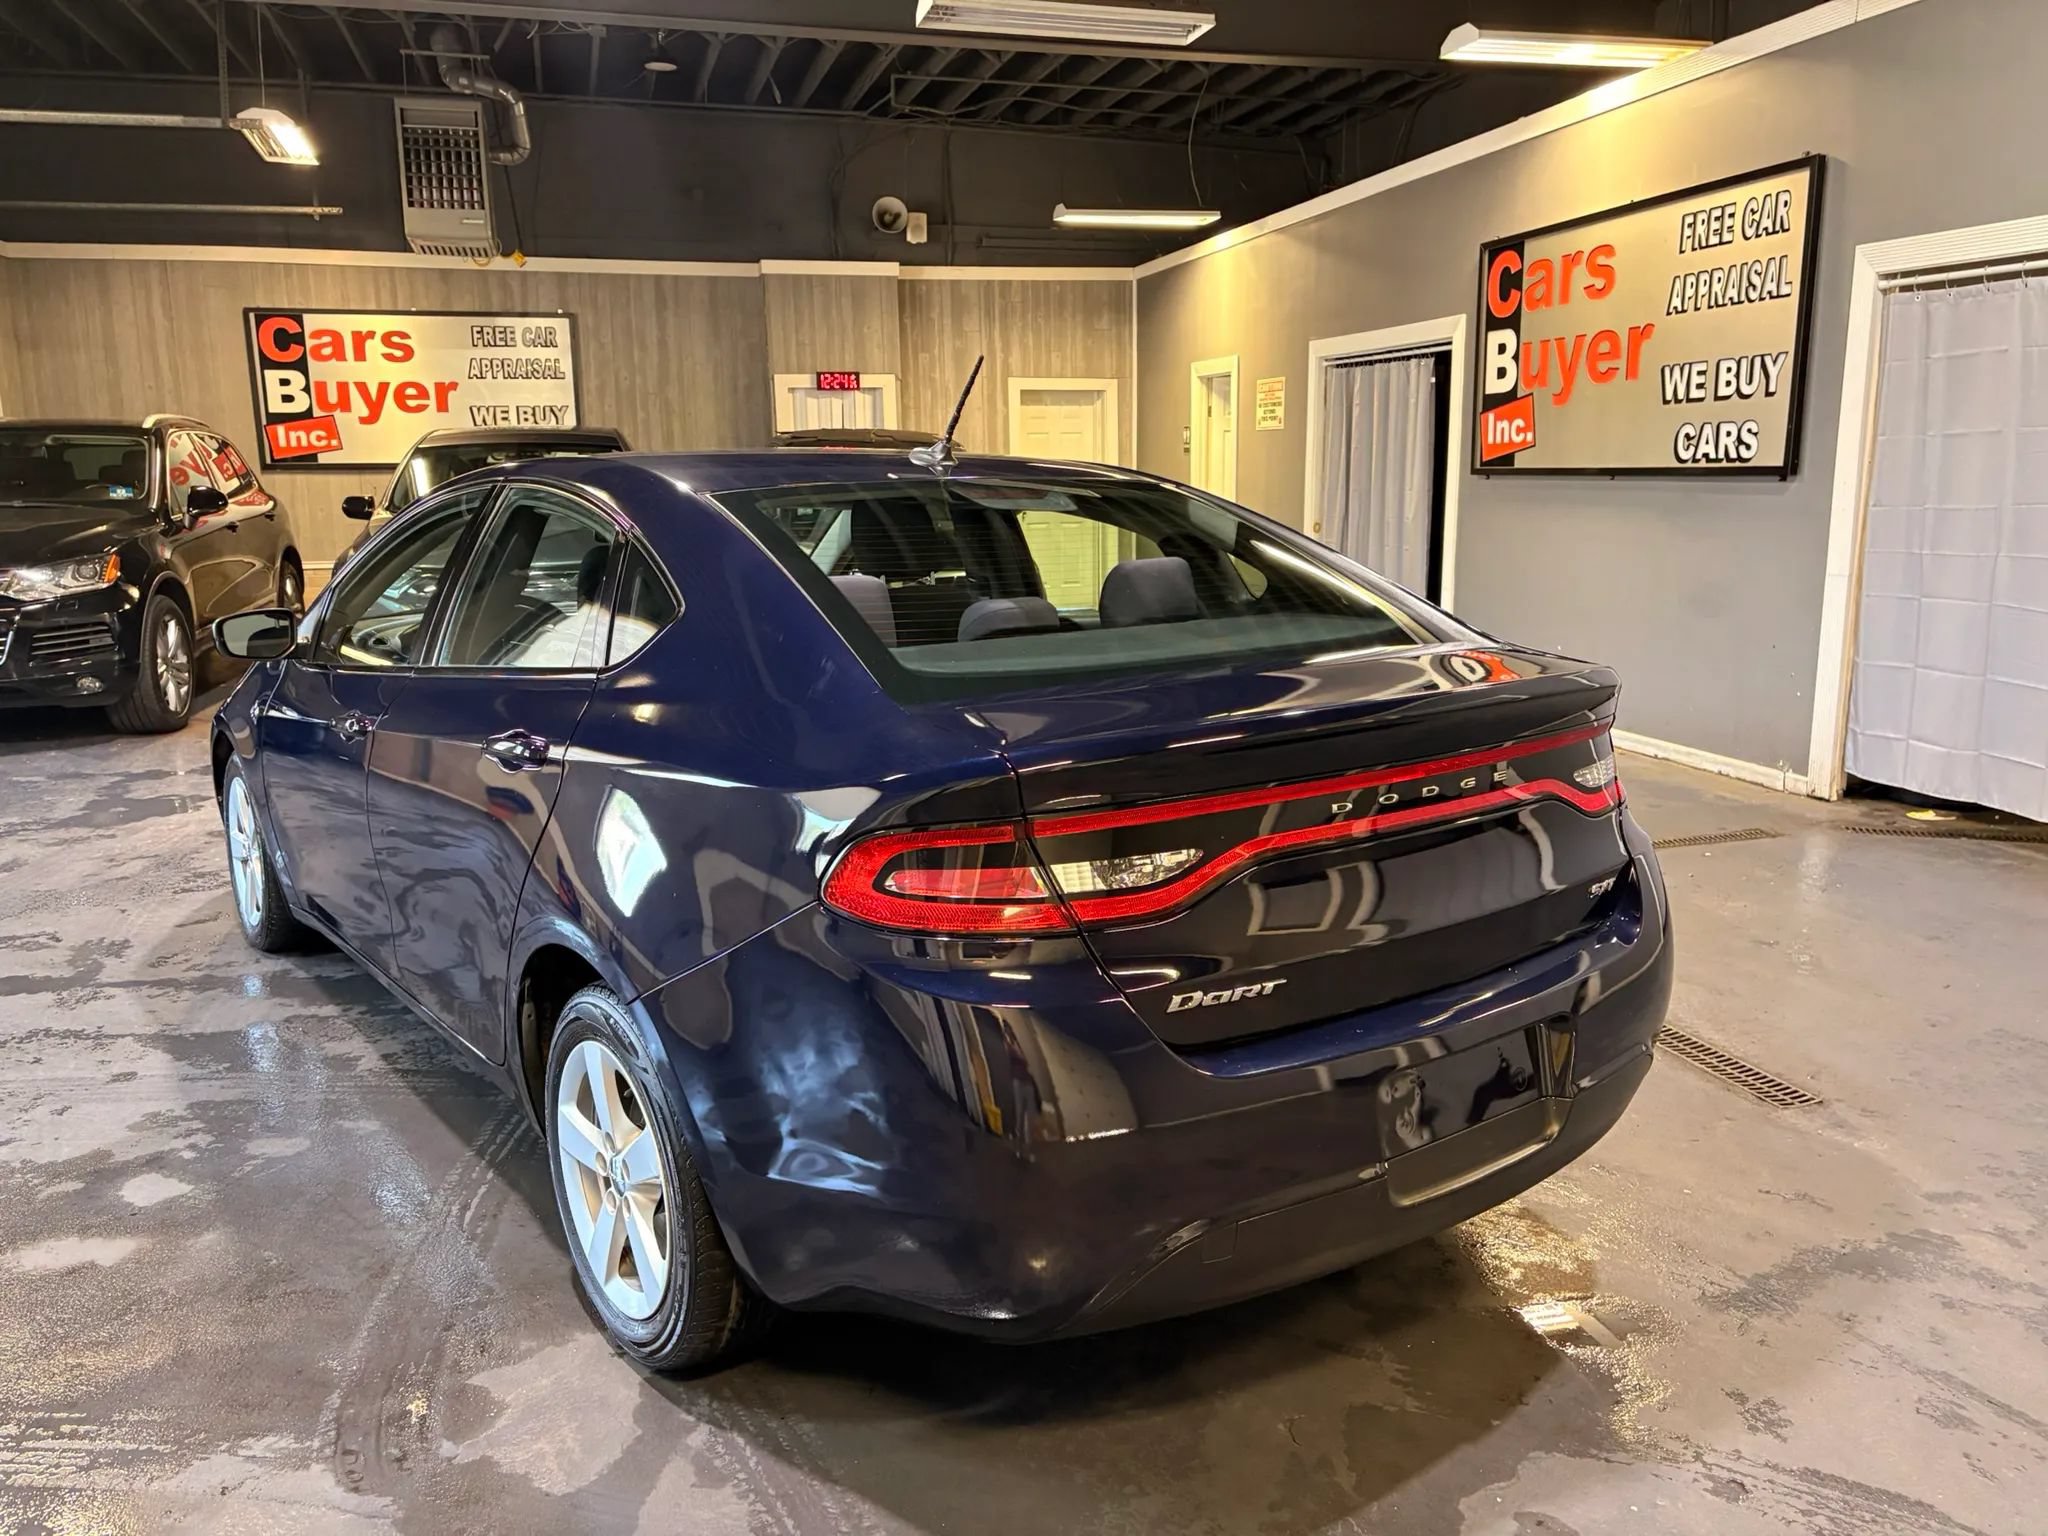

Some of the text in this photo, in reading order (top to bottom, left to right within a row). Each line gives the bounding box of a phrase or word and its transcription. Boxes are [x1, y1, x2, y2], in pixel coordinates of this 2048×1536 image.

[1679, 189, 1792, 254] FREE CAR
[1487, 244, 1617, 319] Cars
[1666, 255, 1793, 316] APPRAISAL
[258, 316, 415, 363] Cars
[471, 325, 558, 348] FREE CAR
[468, 357, 566, 379] APPRAISAL
[820, 373, 849, 389] 12:24
[1484, 323, 1655, 408] Buyer
[1661, 351, 1789, 405] WE BUY
[263, 369, 459, 425] Buyer
[469, 405, 569, 427] WE BUY
[276, 426, 339, 449] Inc.
[1487, 413, 1534, 445] Inc.
[1674, 419, 1760, 464] CARS
[1332, 769, 1508, 815] DODGE
